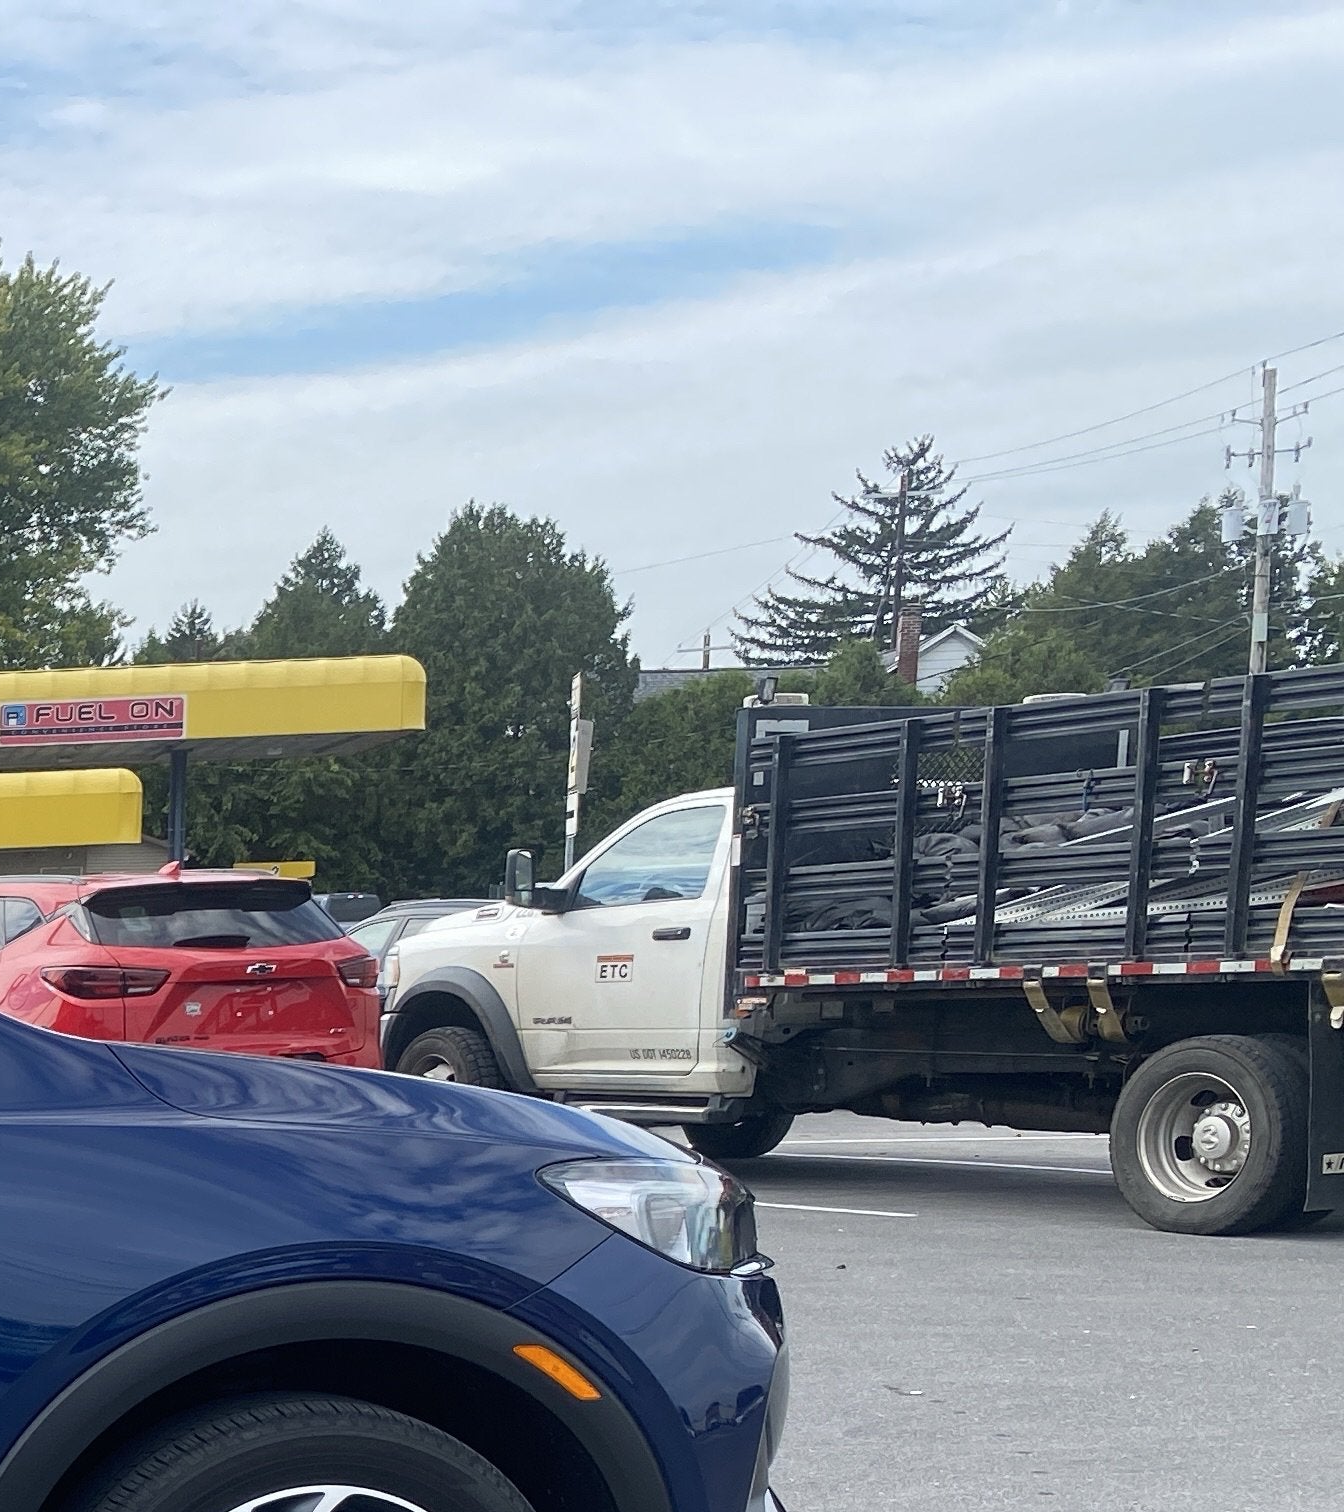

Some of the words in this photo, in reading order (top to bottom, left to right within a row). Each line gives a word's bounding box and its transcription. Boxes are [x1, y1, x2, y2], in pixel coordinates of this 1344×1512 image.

[34, 703, 116, 723] FUEL
[130, 700, 175, 718] ON
[11, 726, 114, 736] CONVENIENCE
[123, 723, 169, 731] STORE
[599, 963, 628, 979] ETC
[629, 1048, 641, 1060] US
